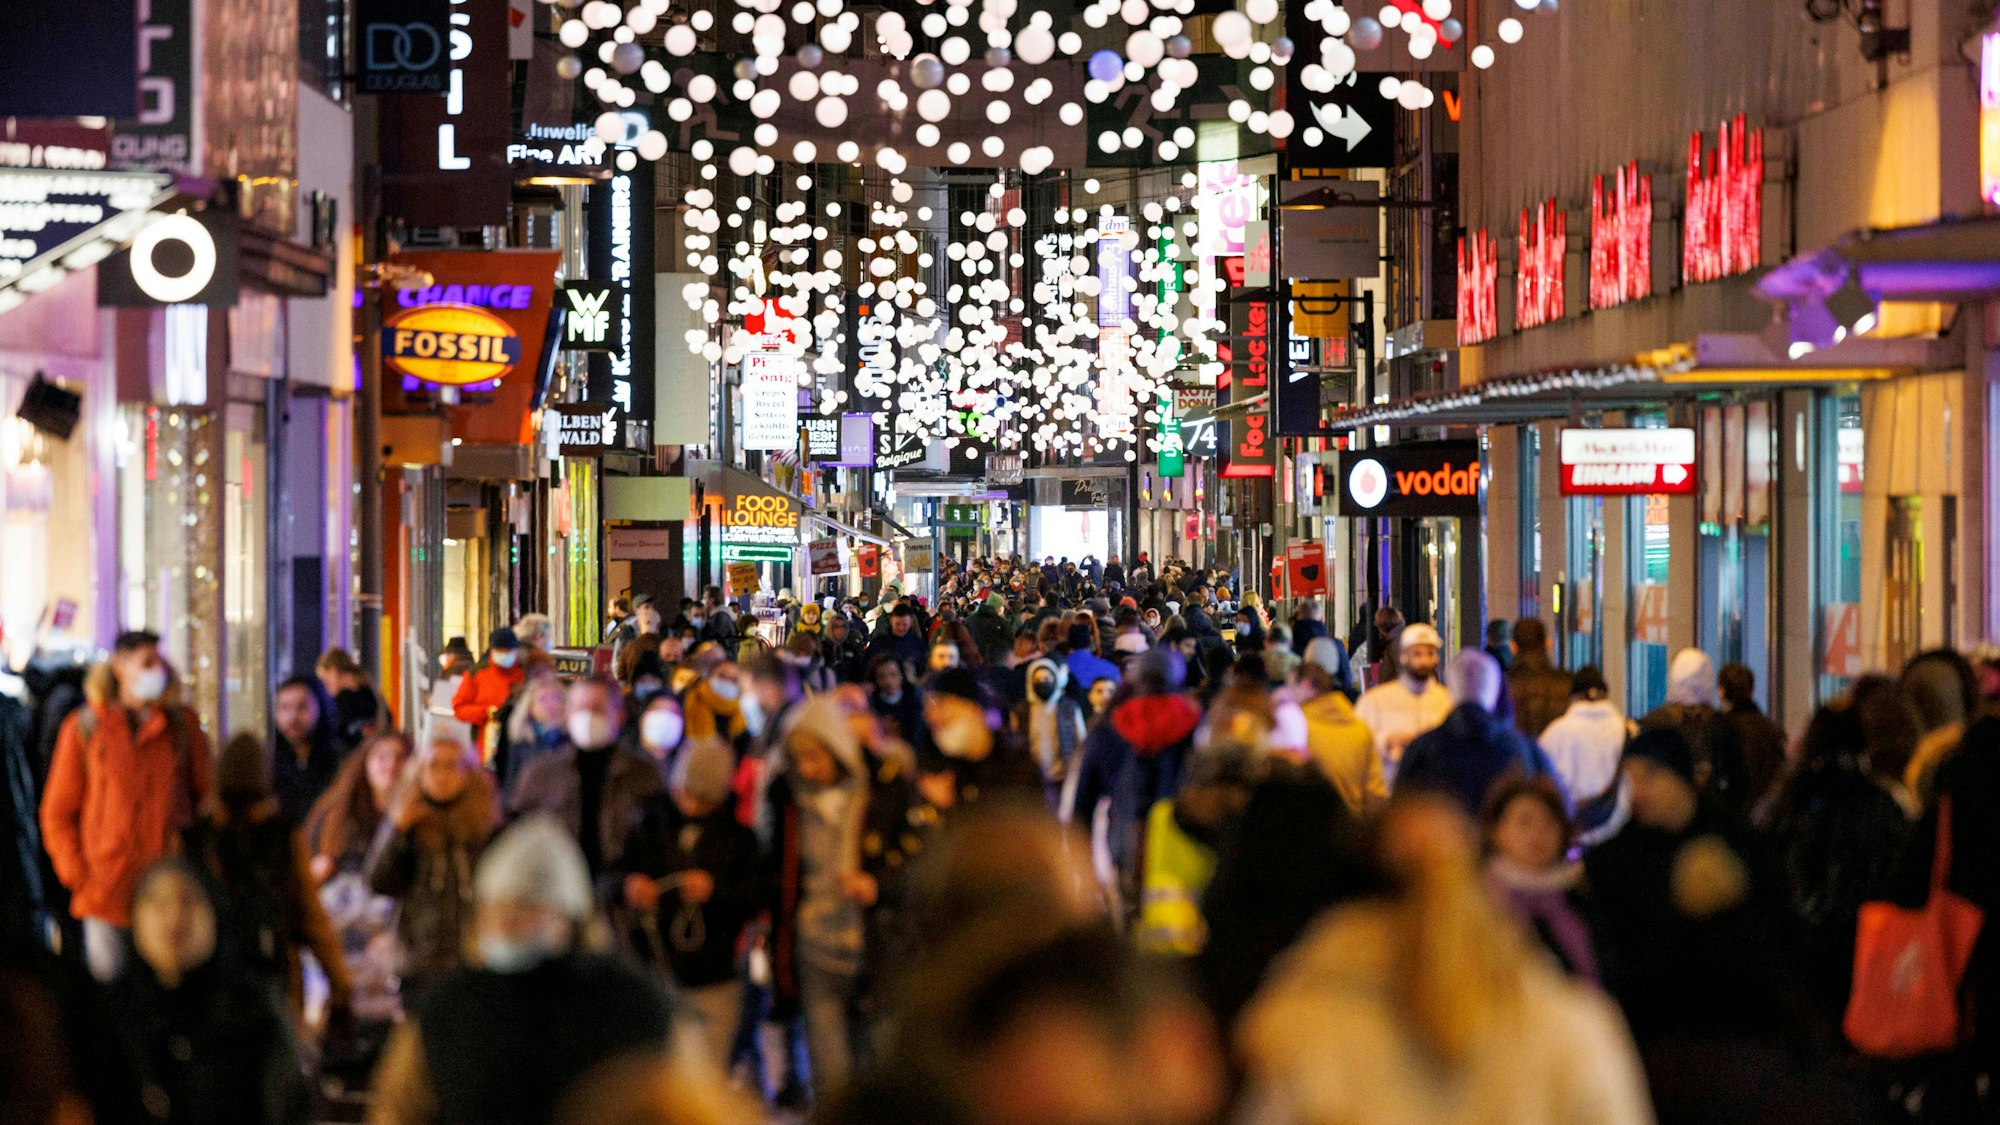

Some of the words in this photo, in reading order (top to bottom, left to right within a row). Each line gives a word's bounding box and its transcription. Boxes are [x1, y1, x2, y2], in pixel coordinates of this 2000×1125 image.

[524, 122, 597, 141] Juwelie
[506, 144, 554, 165] Fine
[557, 144, 607, 165] ART
[1105, 218, 1125, 231] dm
[397, 284, 534, 309] CHANGE
[394, 329, 511, 363] FOSSIL
[559, 415, 601, 429] LBEN
[559, 430, 601, 445] WALD
[876, 448, 922, 469] Belgique
[1396, 462, 1480, 496] vodaf
[736, 494, 789, 512] FOOD
[727, 509, 798, 528] LOUNGE
